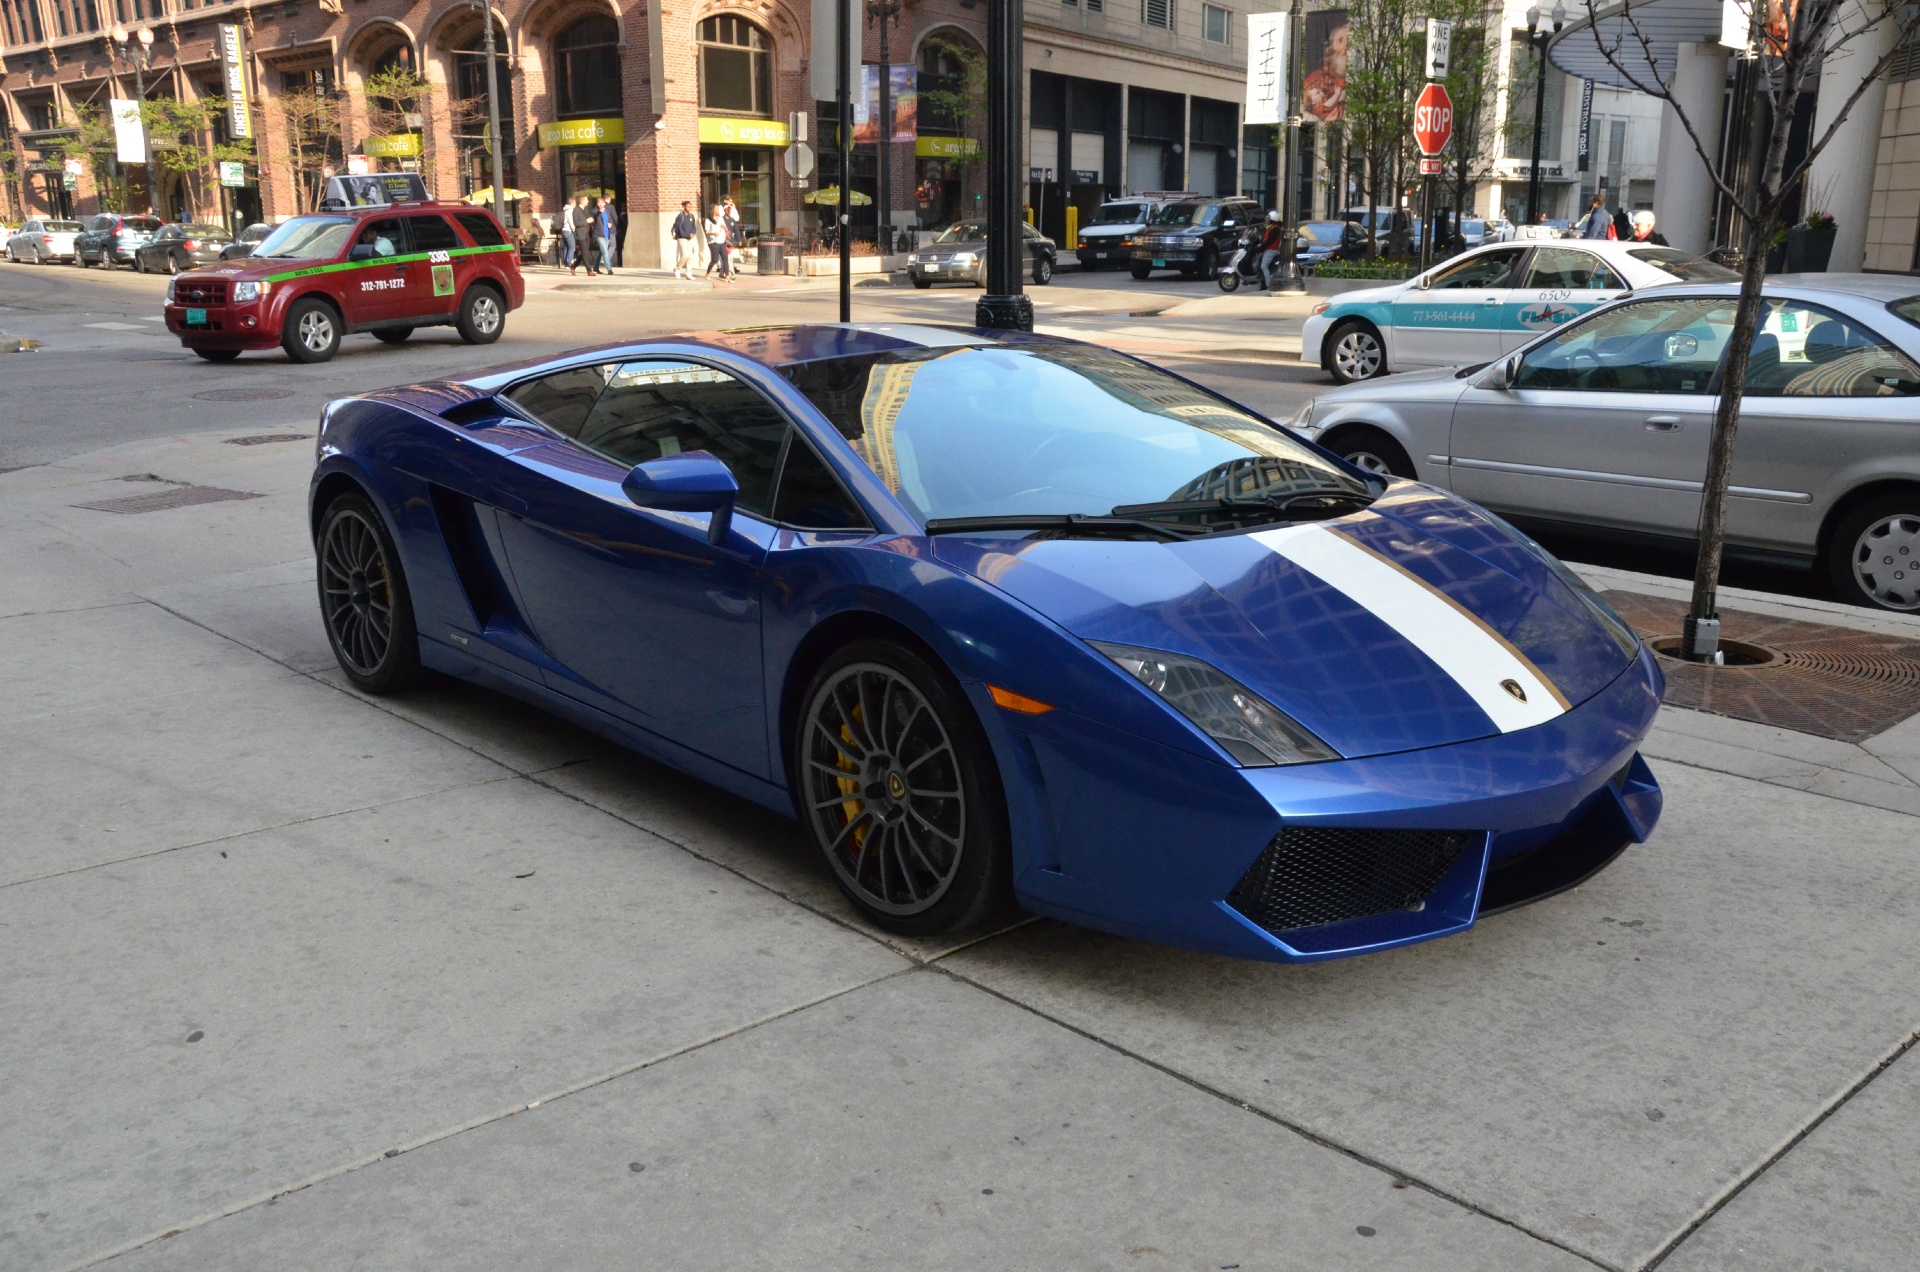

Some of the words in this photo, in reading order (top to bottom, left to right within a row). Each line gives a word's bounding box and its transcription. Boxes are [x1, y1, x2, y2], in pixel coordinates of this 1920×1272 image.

[1431, 25, 1448, 40] ONE
[224, 26, 240, 63] BAGELS
[1431, 41, 1448, 55] WAY
[232, 92, 247, 136] EINSTEIN
[1417, 105, 1450, 133] STOP
[562, 127, 575, 140] tea
[577, 119, 604, 139] café
[739, 127, 763, 143] argo
[764, 126, 776, 140] tea
[388, 136, 409, 151] café
[1579, 133, 1588, 156] rack
[1422, 162, 1430, 171] ALL
[1431, 162, 1439, 171] WAY
[1548, 164, 1563, 176] rack
[428, 250, 450, 263] 3383
[361, 278, 406, 292] 312-791-1272
[1539, 289, 1571, 301] 6509
[1413, 311, 1476, 322] 773-561-4444
